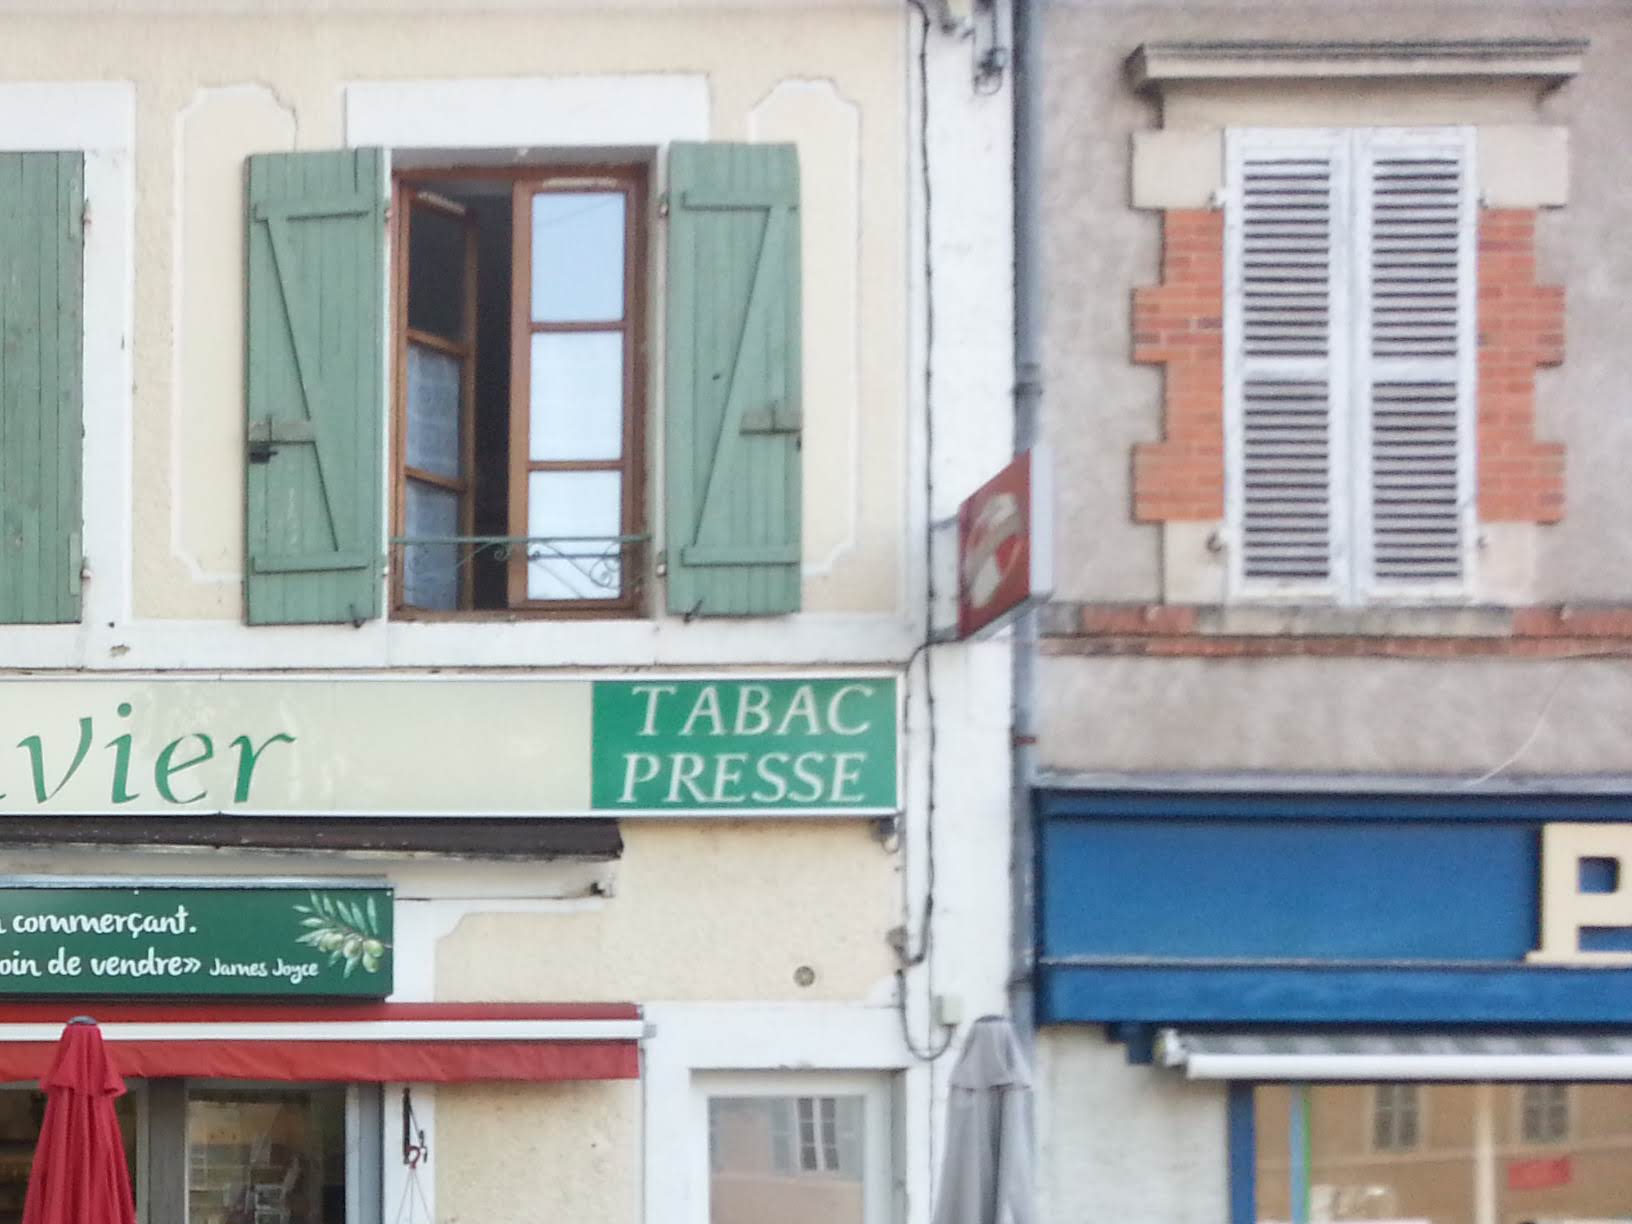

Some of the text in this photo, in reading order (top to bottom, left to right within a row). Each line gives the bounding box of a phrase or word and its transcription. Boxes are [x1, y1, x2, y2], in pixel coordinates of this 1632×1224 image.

[631, 683, 874, 736] TABAC
[617, 752, 866, 803] PRESSE
[12, 904, 197, 938] commerçant.
[47, 947, 82, 977] de
[209, 956, 268, 978] James
[272, 958, 319, 984] Joyce
